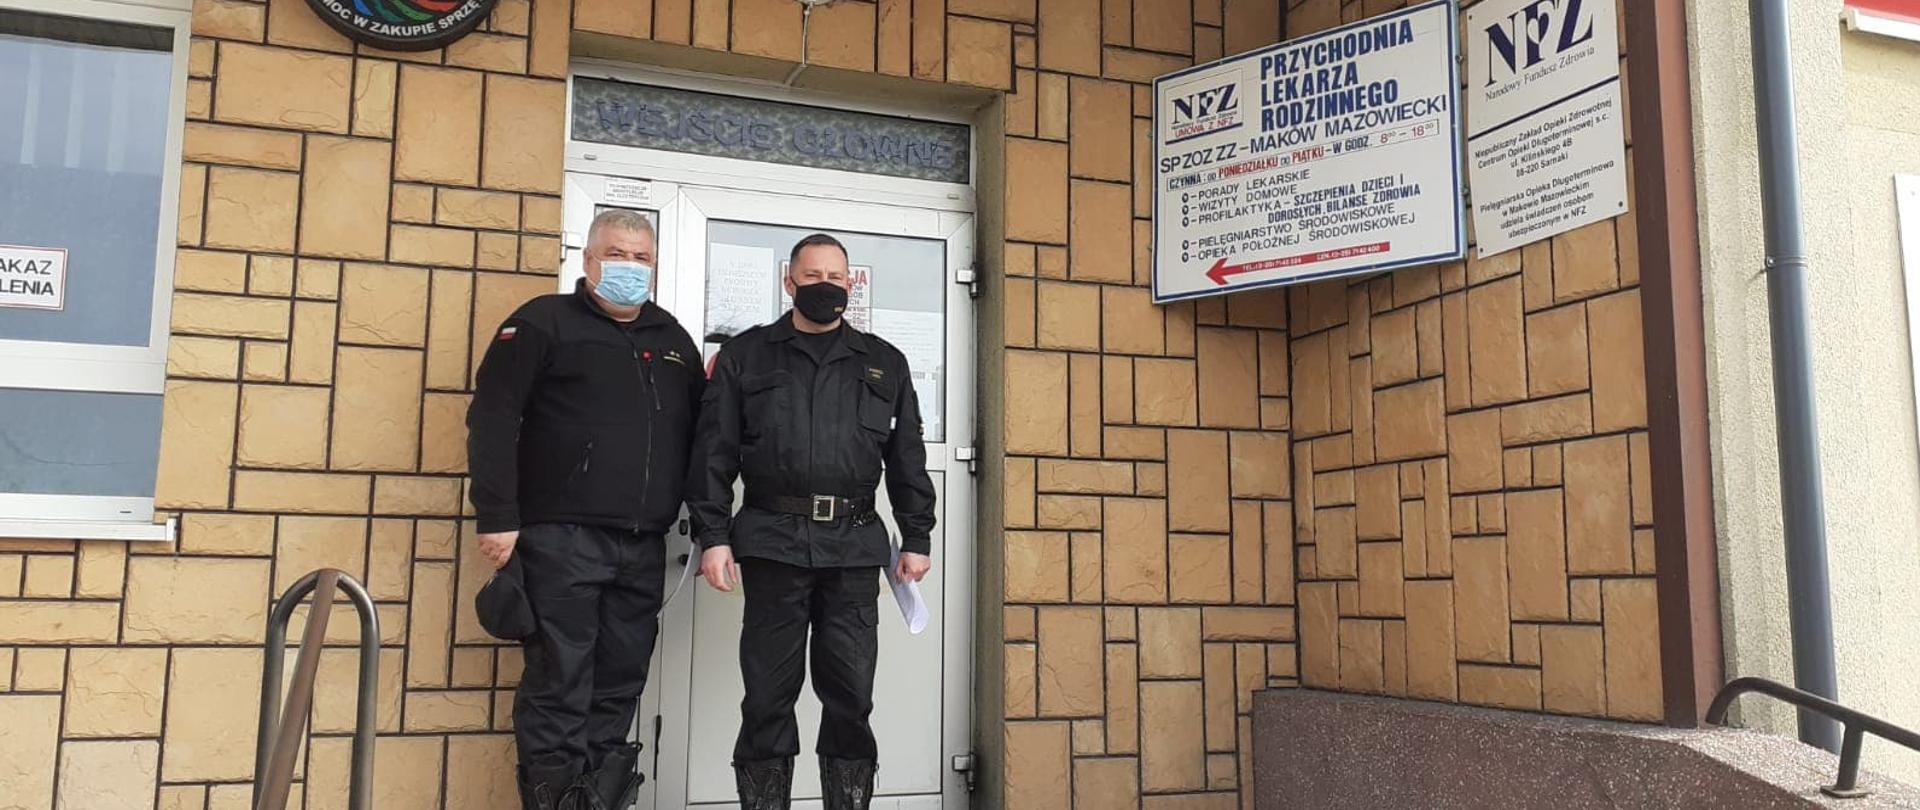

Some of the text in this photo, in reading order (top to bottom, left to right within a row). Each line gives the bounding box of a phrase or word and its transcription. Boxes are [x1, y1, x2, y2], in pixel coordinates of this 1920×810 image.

[353, 15, 369, 28] W
[368, 21, 437, 37] ZAKUPIE
[1484, 0, 1594, 88] NFZ
[1260, 19, 1414, 80] PRZYCHODNIA
[1260, 62, 1359, 106] LEKARZA
[1484, 45, 1595, 102] Narodowy Fundusz Zdrowia
[1171, 83, 1239, 124] NFZ
[1261, 79, 1398, 132] RODZINNEGO
[1325, 94, 1447, 138] MAZOWIECKI
[1198, 168, 1311, 201] PORADY LEKARSKIE
[1199, 184, 1297, 212] WIZYTY DOMOWE
[1199, 200, 1281, 225] PROFILAKTYKA
[1294, 183, 1356, 206] SZCZEPIENIA
[1361, 175, 1394, 193] DZIECI
[1400, 173, 1404, 184] I
[1326, 194, 1368, 213] BILANSE
[1373, 183, 1421, 204] ZDROWIA
[1563, 192, 1594, 208] osobom
[1571, 205, 1588, 217] NFZ
[1198, 245, 1236, 261] OPIEKA
